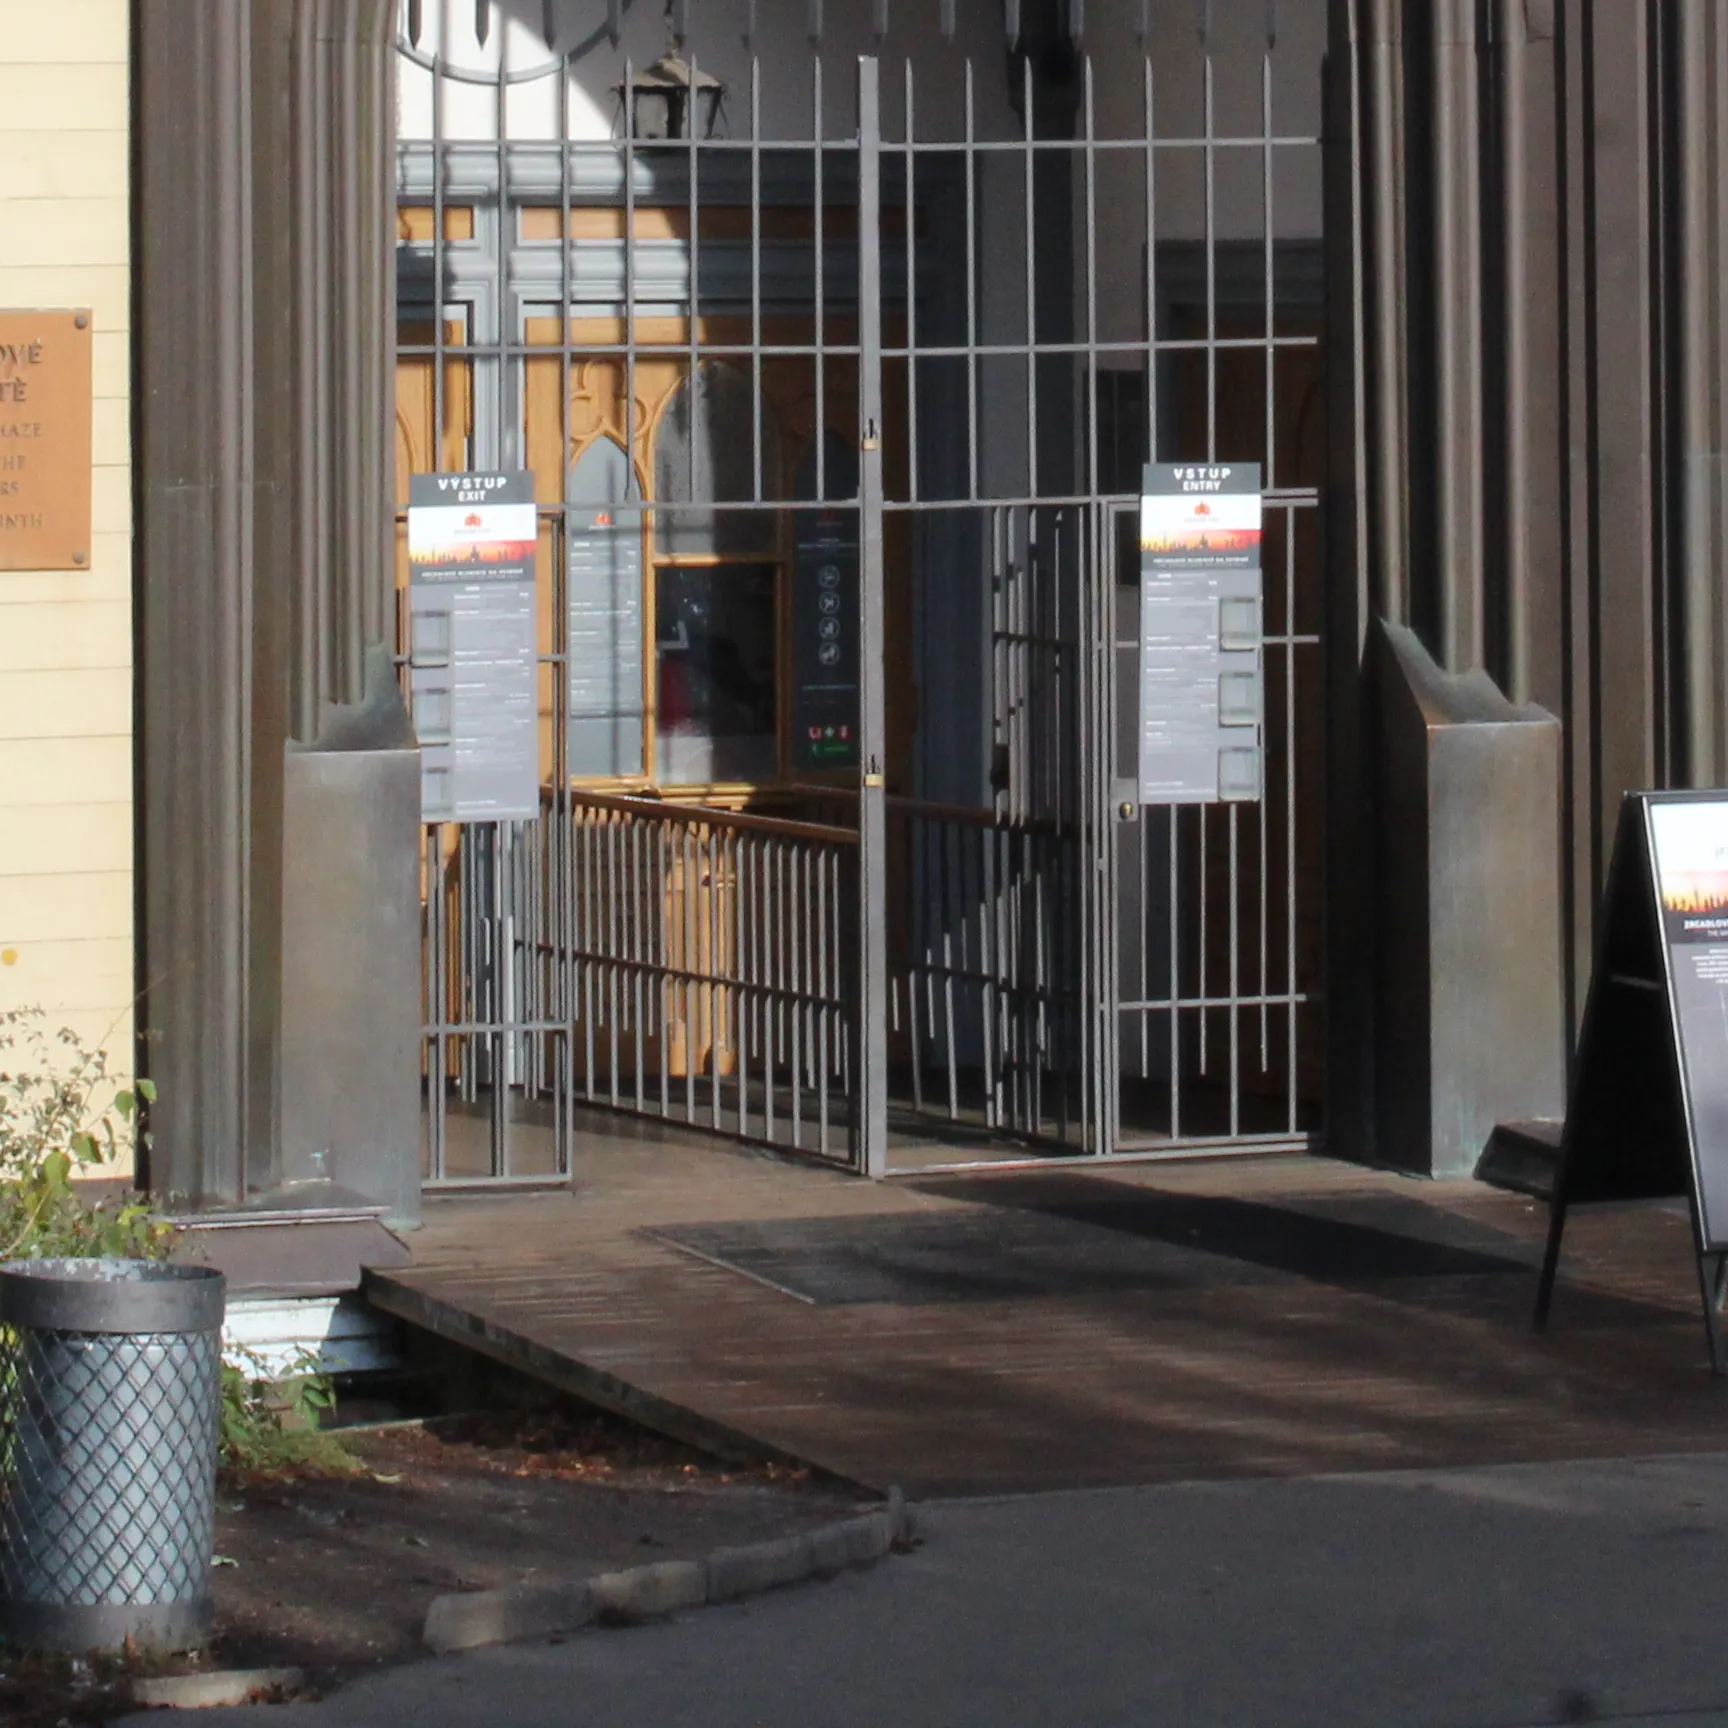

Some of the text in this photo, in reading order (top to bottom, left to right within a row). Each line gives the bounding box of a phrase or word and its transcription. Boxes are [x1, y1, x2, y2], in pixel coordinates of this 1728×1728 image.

[1173, 467, 1232, 480] VSTUP
[437, 476, 507, 491] VÝSTUP
[1183, 480, 1221, 491] ENTRY
[458, 490, 487, 502] EXIT
